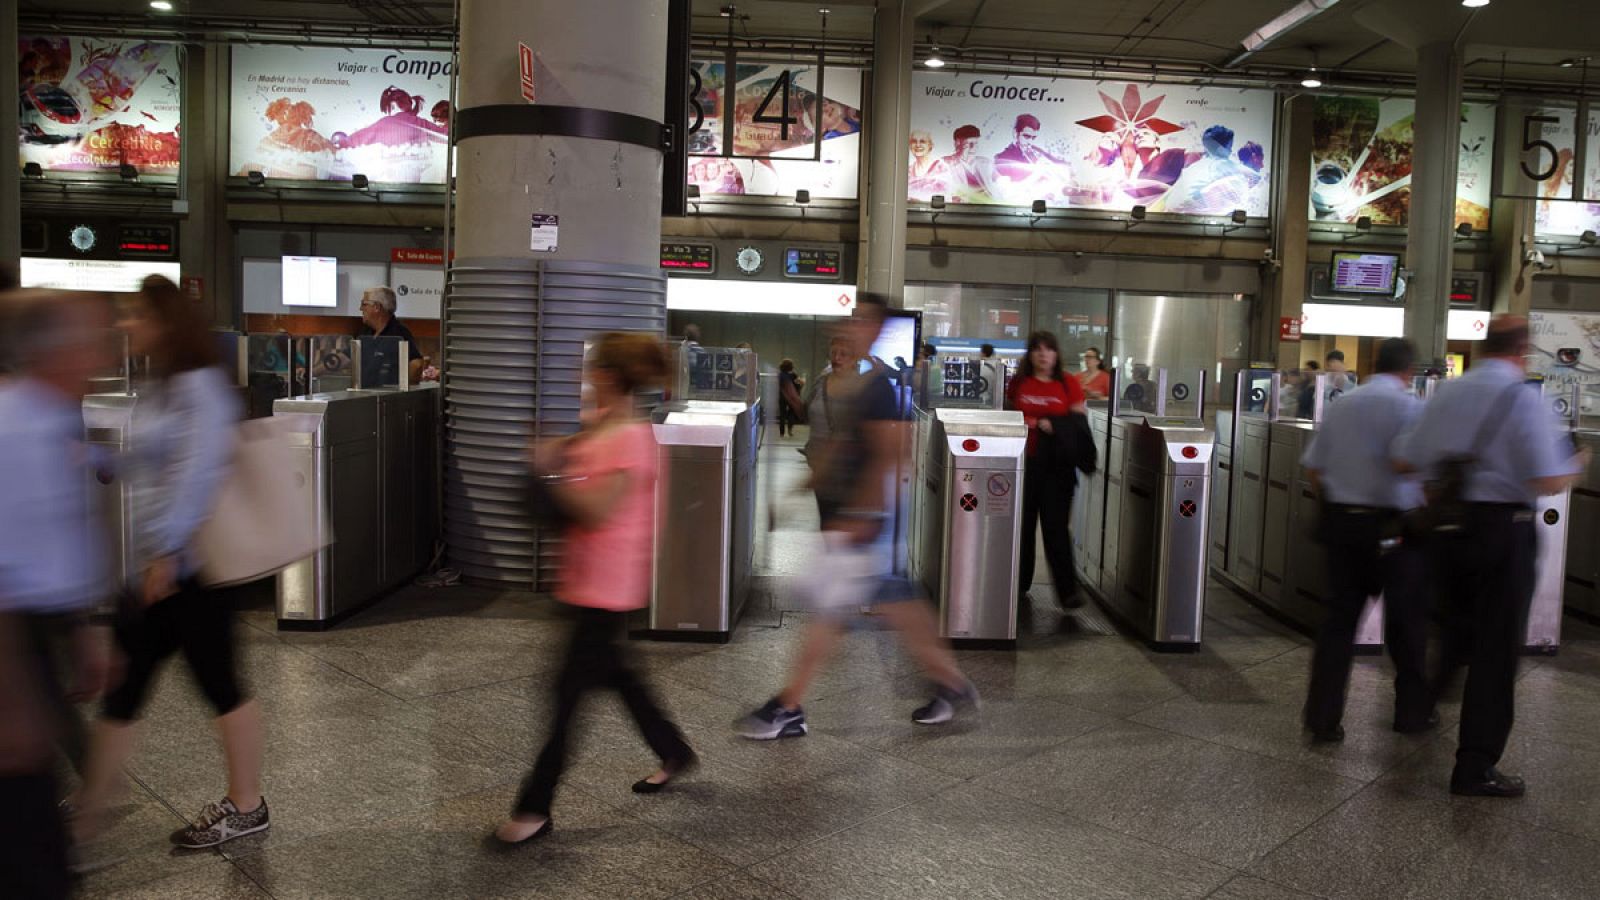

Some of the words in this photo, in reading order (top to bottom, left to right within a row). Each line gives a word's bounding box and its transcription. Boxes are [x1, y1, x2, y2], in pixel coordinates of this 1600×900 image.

[258, 74, 285, 83] Madrid
[337, 61, 369, 75] Viajar
[925, 85, 955, 98] Viajar
[969, 80, 1065, 103] Conocer...
[752, 70, 797, 141] 4
[1521, 115, 1559, 181] 5
